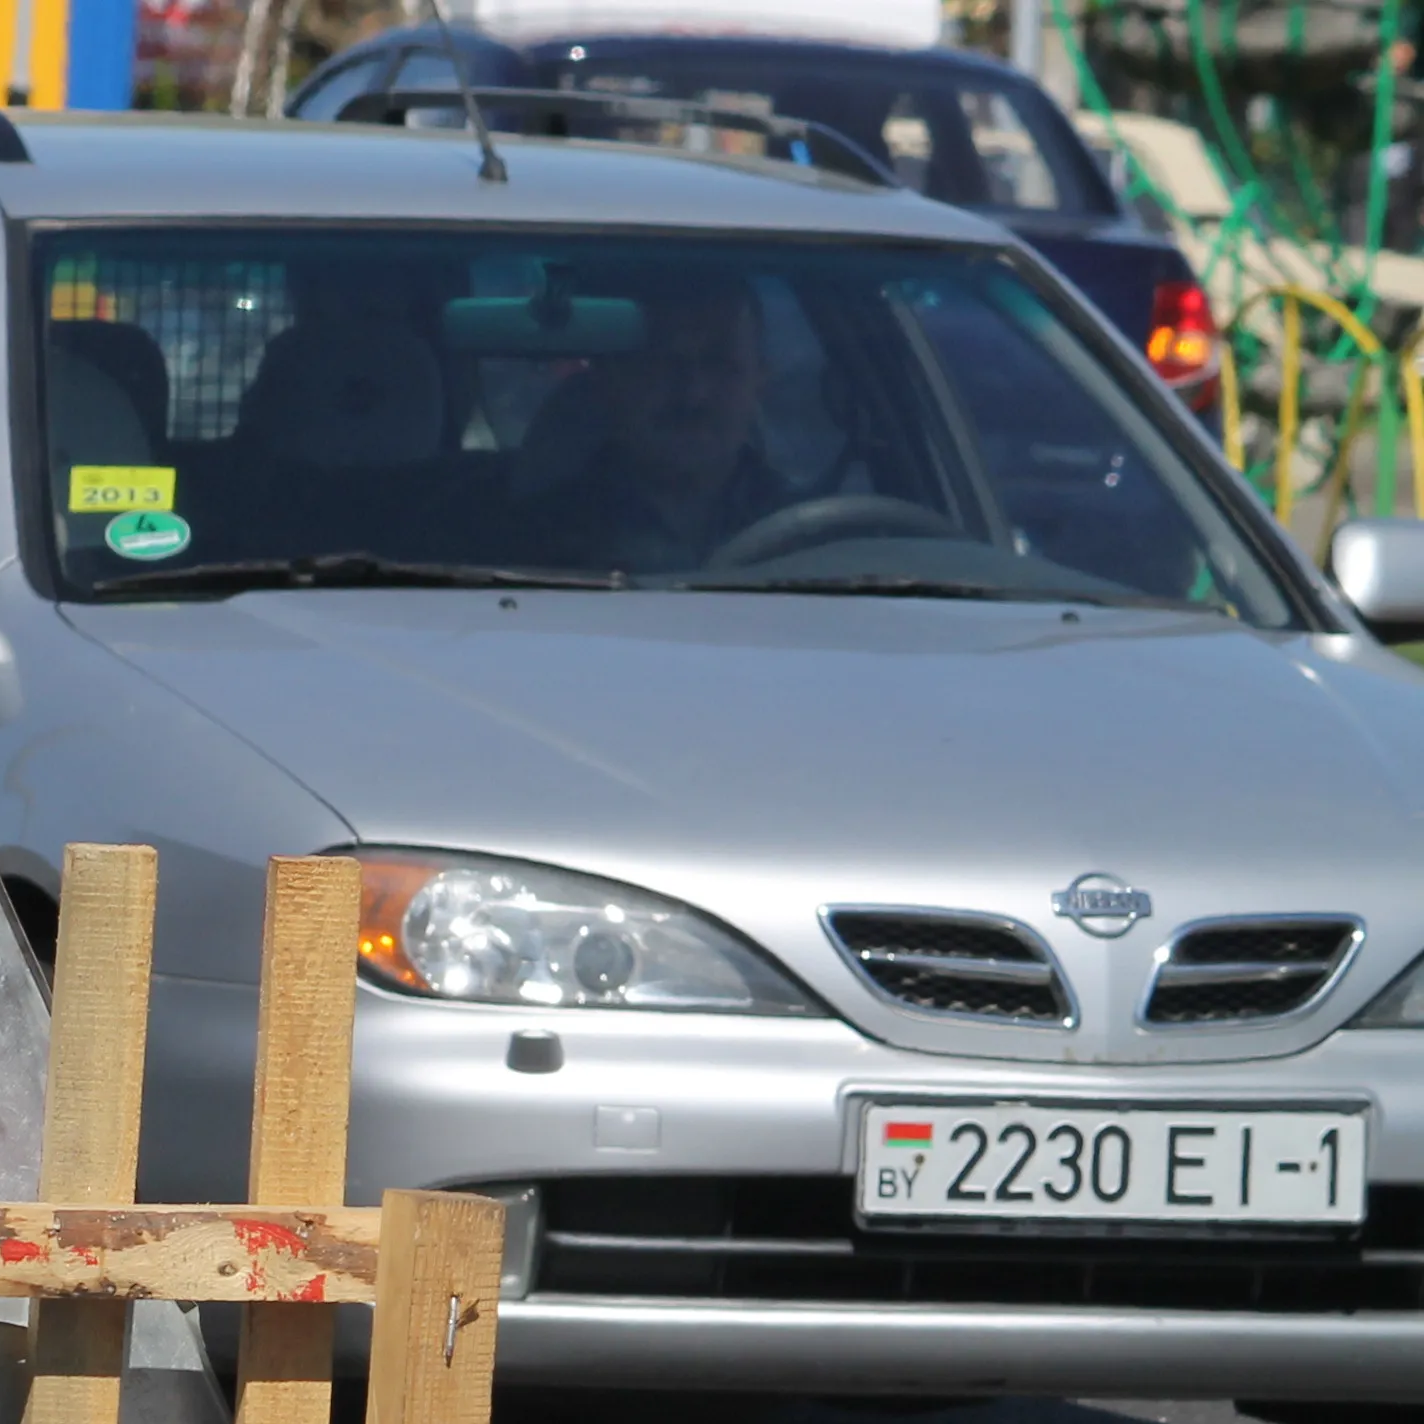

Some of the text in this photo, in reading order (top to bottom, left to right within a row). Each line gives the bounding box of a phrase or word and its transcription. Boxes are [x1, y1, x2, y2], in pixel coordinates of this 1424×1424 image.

[82, 487, 161, 505] 2013
[947, 1123, 1340, 1208] 2230 EI-1
[877, 1168, 921, 1199] BY
